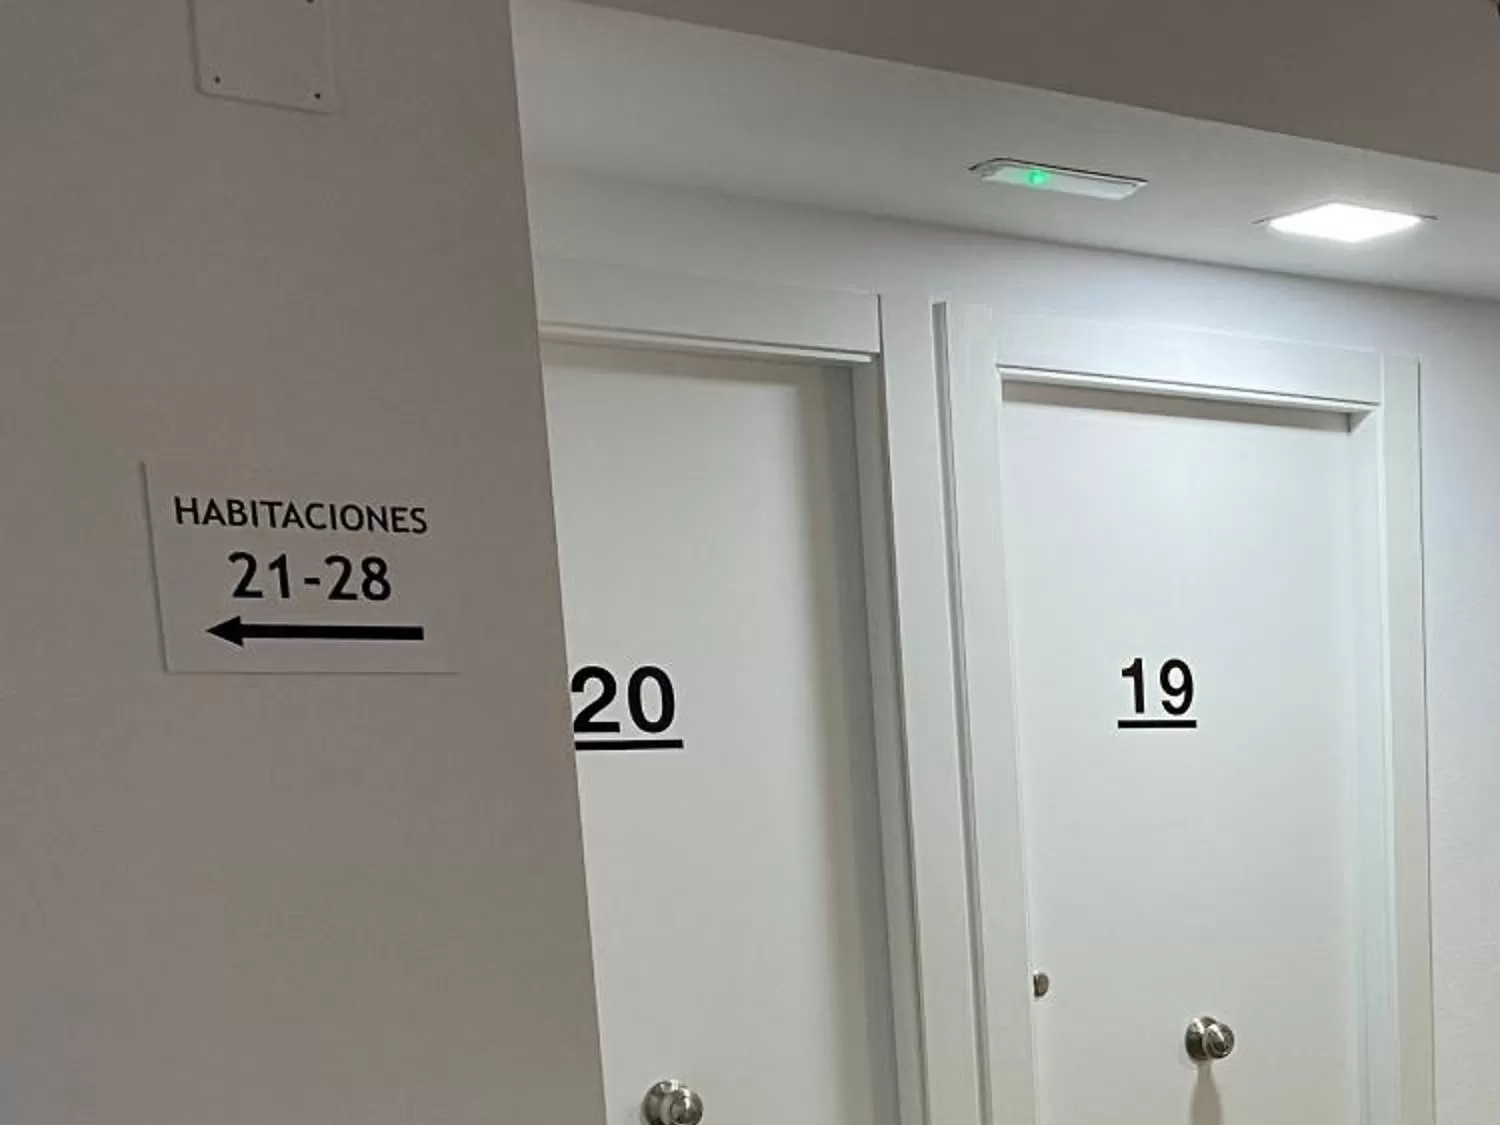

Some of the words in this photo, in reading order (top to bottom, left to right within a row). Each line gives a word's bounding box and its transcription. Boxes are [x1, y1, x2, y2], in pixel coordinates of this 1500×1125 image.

[173, 495, 428, 535] HABITACIONES
[227, 551, 392, 602] 21-28
[571, 665, 676, 734] 20
[1120, 658, 1195, 716] 19
